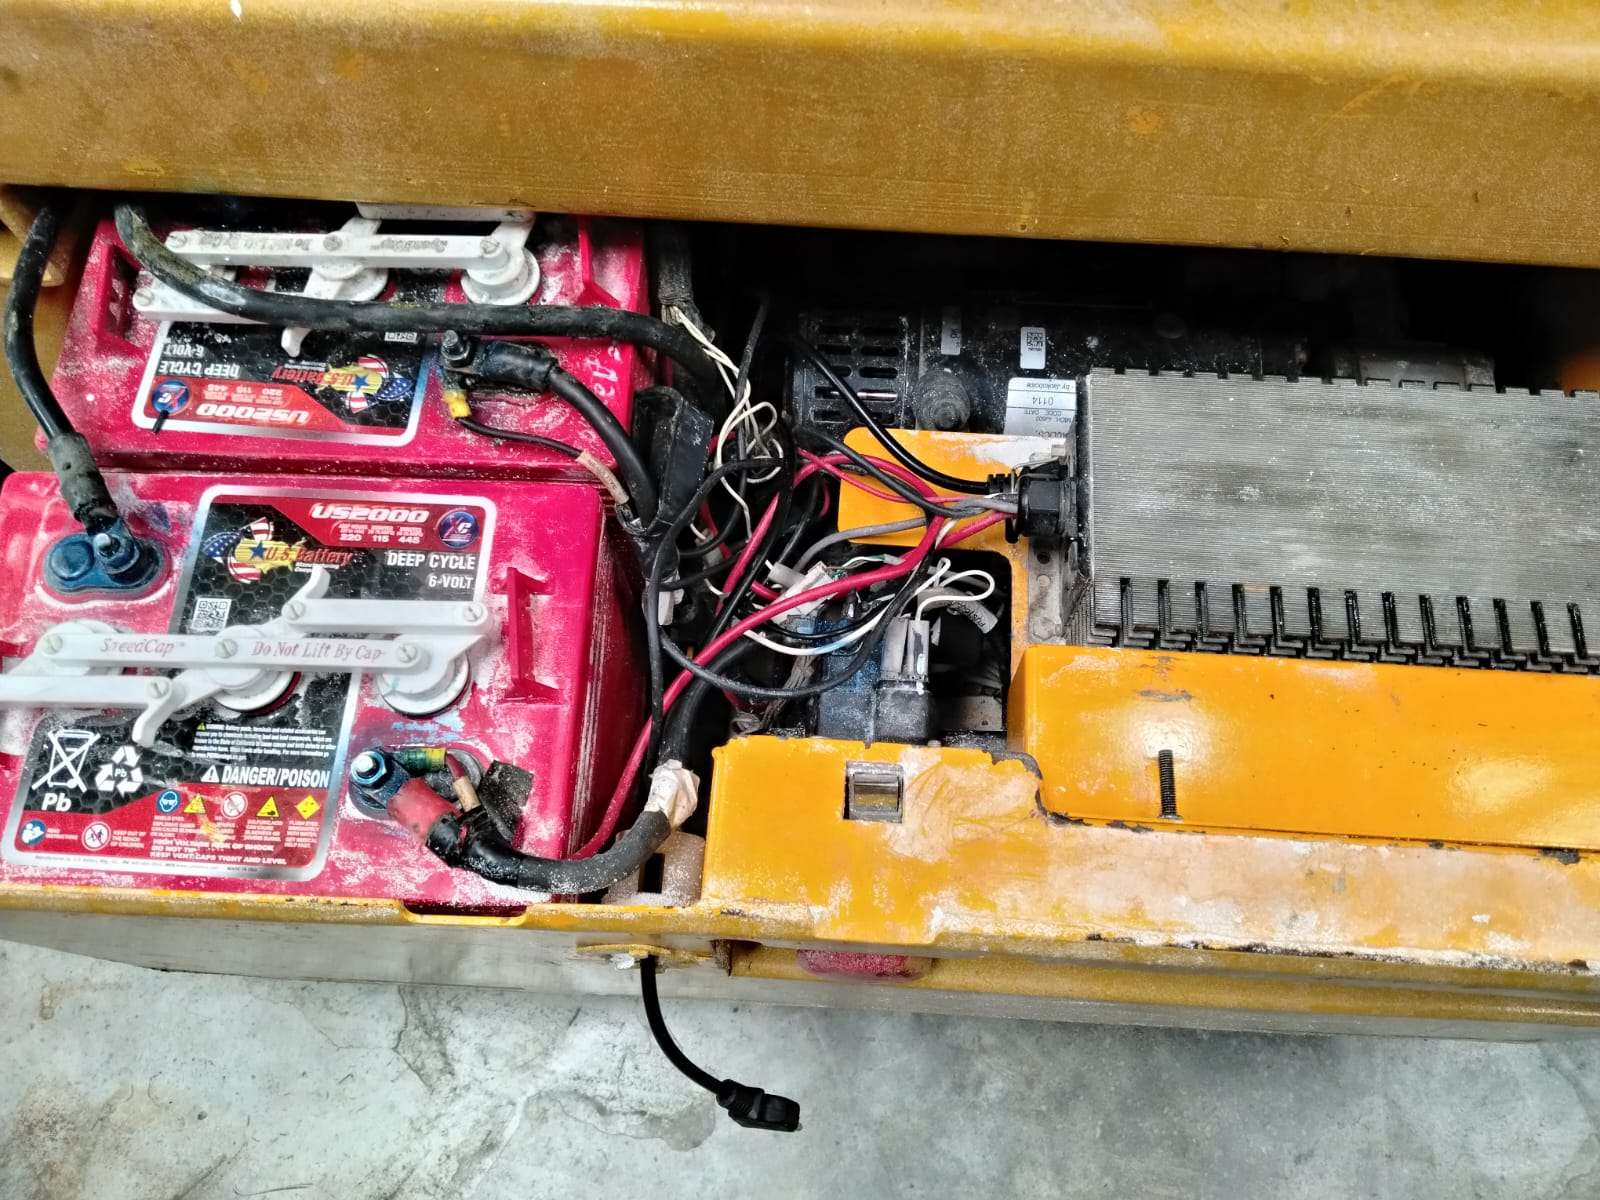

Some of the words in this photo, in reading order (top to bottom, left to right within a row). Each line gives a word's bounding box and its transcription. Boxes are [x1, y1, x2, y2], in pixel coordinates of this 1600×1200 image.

[164, 343, 204, 357] 6-VOLT
[159, 360, 202, 376] CYCLE
[204, 363, 241, 378] DEEP
[1032, 396, 1054, 406] 0114
[195, 403, 310, 424] US2000
[310, 504, 431, 523] US2000
[339, 533, 362, 542] 220
[372, 535, 389, 543] 115
[295, 547, 353, 567] Battery
[386, 552, 426, 568] DEEP
[428, 554, 477, 570] CYCLE
[428, 575, 474, 589] 6-VOLT
[252, 640, 272, 656] Do
[273, 641, 300, 658] Not
[302, 642, 331, 659] Lift
[333, 644, 354, 660] By
[355, 645, 386, 661] Cap
[114, 768, 128, 778] Pb
[221, 765, 331, 788] DANGER/POISON
[41, 793, 72, 812] Pb
